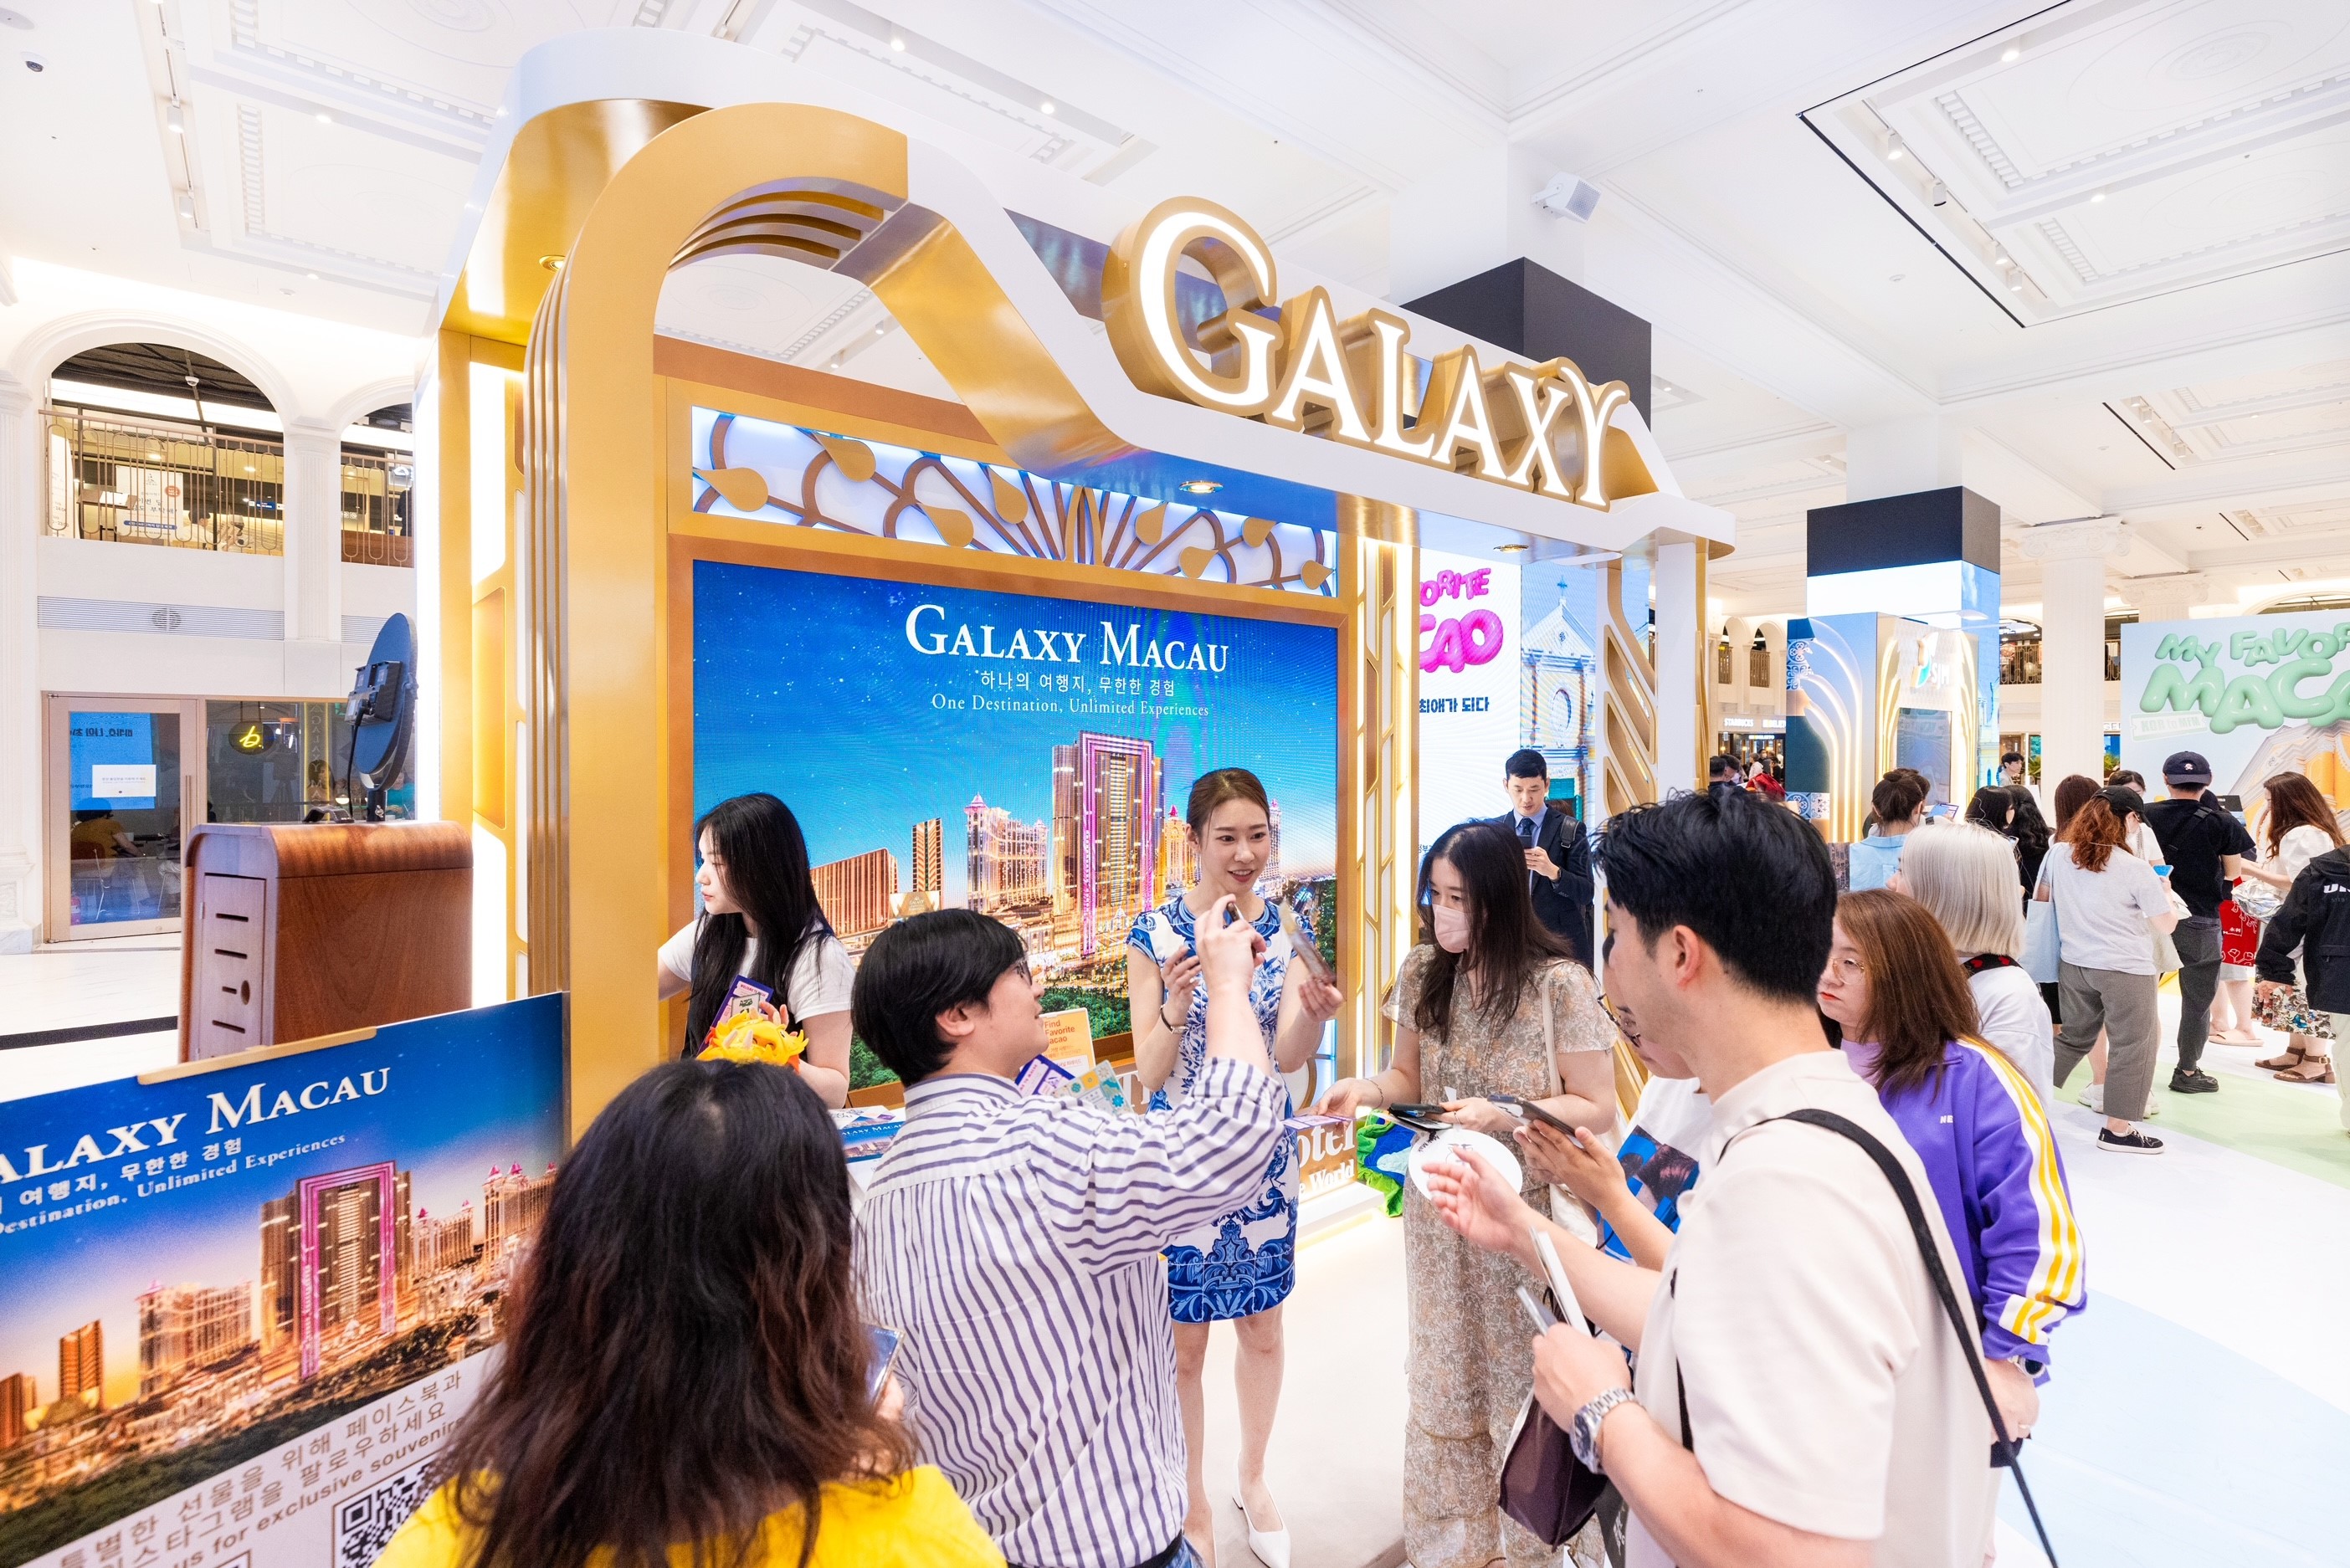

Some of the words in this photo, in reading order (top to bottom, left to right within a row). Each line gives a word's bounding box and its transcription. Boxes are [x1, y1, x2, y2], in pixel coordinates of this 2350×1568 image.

[1113, 195, 1630, 513] GALAXY
[1419, 568, 1491, 607] ORITE
[906, 604, 1086, 664] GALAXY
[1100, 621, 1229, 673] MACAU
[2155, 633, 2223, 669] MY
[981, 671, 1029, 690] 하나의
[1039, 674, 1092, 695] 여행지,
[1099, 677, 1142, 695] 무한한
[1150, 679, 1175, 697] 경험
[931, 694, 965, 710] One
[972, 695, 1063, 713] Destination,
[1070, 698, 1135, 715] Unlimited
[1141, 701, 1208, 718] Experiences
[1419, 698, 1458, 713] 최애가
[1462, 696, 1490, 712] 되다
[2141, 719, 2165, 733] KOR
[1044, 1019, 1061, 1029] Find
[1044, 1026, 1075, 1037] Favorite
[1049, 1036, 1068, 1044] acao
[205, 1068, 391, 1135] MACAU
[1297, 1120, 1355, 1169] otel
[19, 1173, 109, 1206] 여행지,
[121, 1150, 189, 1182] 무한한
[202, 1137, 242, 1161] 경험
[137, 1159, 238, 1198] Unlimited
[244, 1135, 346, 1169] Experiences
[1309, 1159, 1355, 1192] World
[177, 1465, 264, 1523] 선물을
[281, 1432, 331, 1471] 위해
[345, 1371, 462, 1439] 페이스북과
[300, 1401, 445, 1489] 팔로우하세요
[213, 1525, 249, 1554] for
[256, 1470, 362, 1531] exclusive
